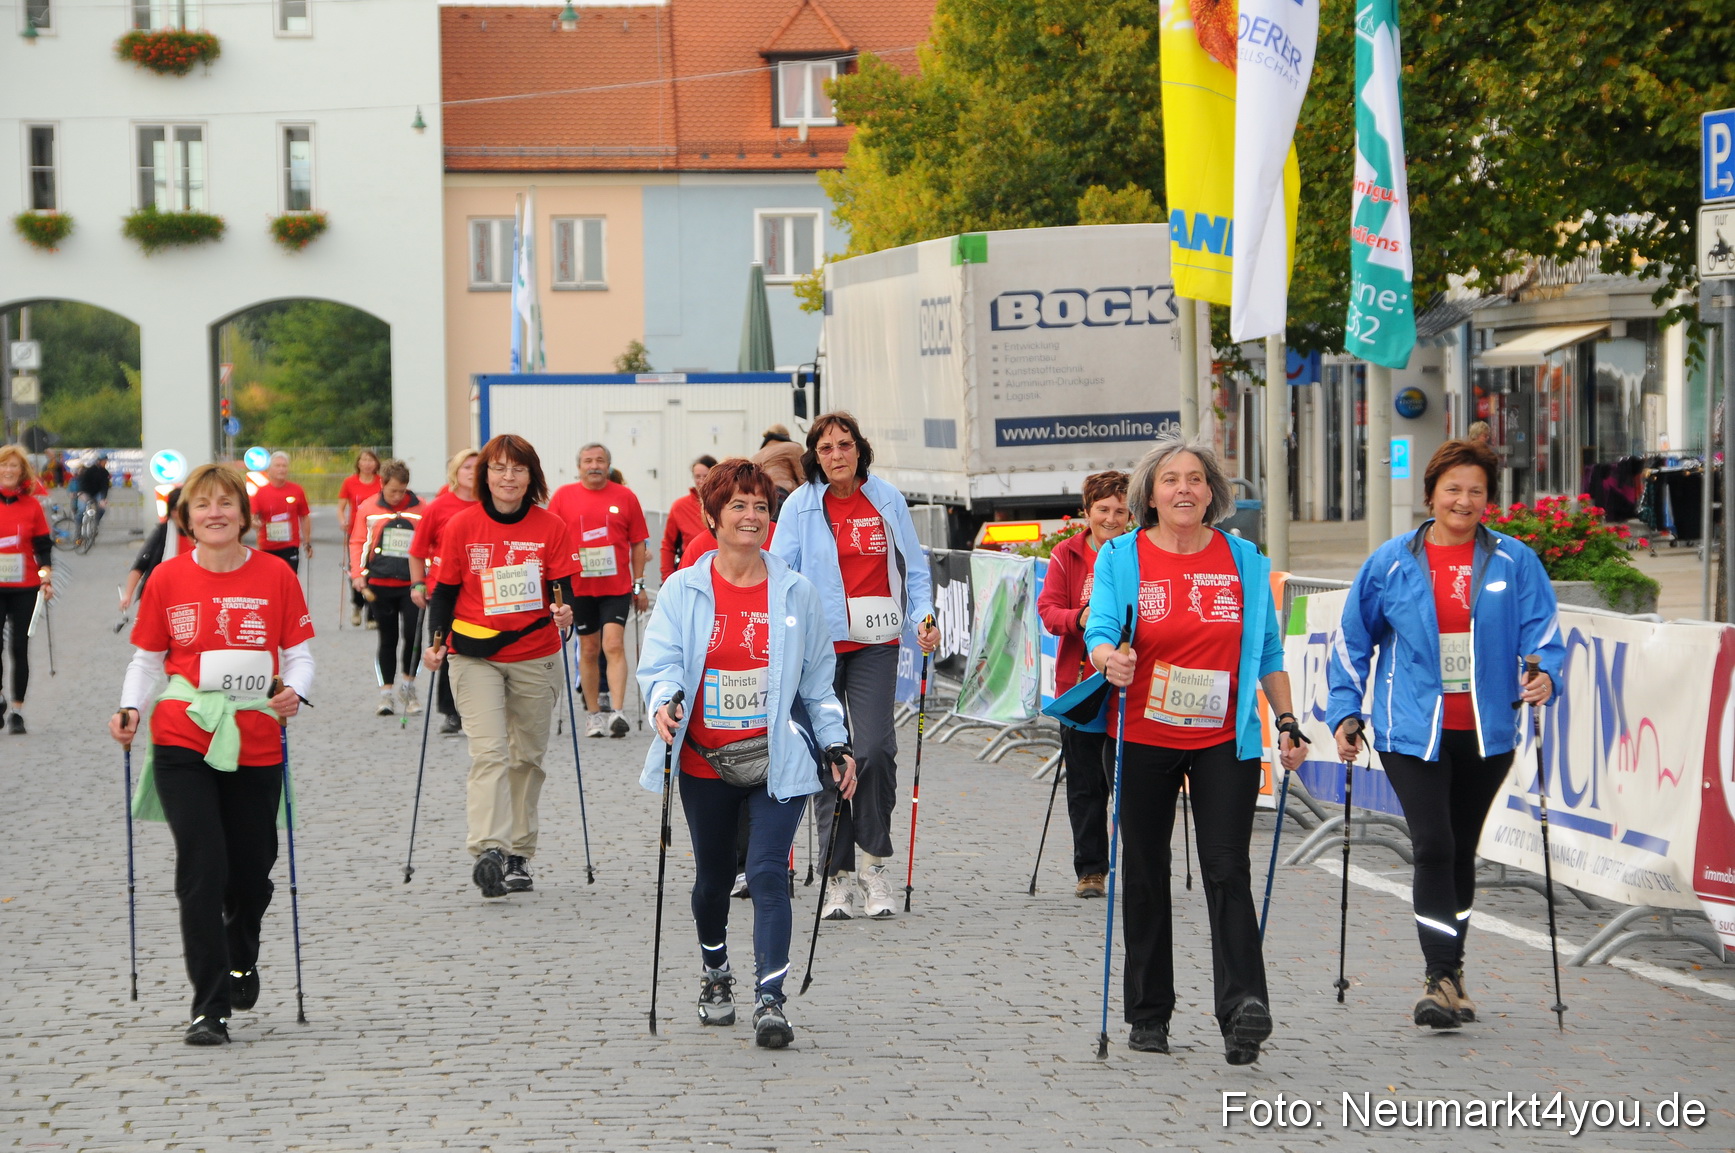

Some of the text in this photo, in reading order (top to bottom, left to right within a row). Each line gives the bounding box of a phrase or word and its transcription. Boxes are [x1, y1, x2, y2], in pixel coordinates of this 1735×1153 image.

[1708, 122, 1732, 190] P
[1714, 213, 1728, 227] nur
[991, 284, 1178, 331] BOCK
[921, 296, 952, 356] BOCK
[1004, 341, 1060, 351] Entwicklung
[1004, 354, 1057, 363] Formenbau
[1005, 364, 1085, 376] Kunststofftechnik
[1005, 376, 1105, 388] Aluminium-Druckguss
[1006, 391, 1041, 402] Logistik
[1002, 417, 1181, 441] www.bockonline.de
[496, 568, 528, 580] Gabriele
[1193, 573, 1239, 582] NEUMARKTER
[500, 581, 536, 598] 8020
[1139, 599, 1165, 610] NEU
[866, 612, 898, 628] 8118
[1141, 609, 1165, 617] MARKT
[173, 623, 194, 633] NEU
[222, 674, 265, 691] 8100
[722, 675, 757, 687] Christa
[1173, 670, 1215, 687] Mathilde
[723, 691, 768, 710] 8047
[1170, 690, 1221, 711] 8046
[1495, 825, 1524, 850] MICRO
